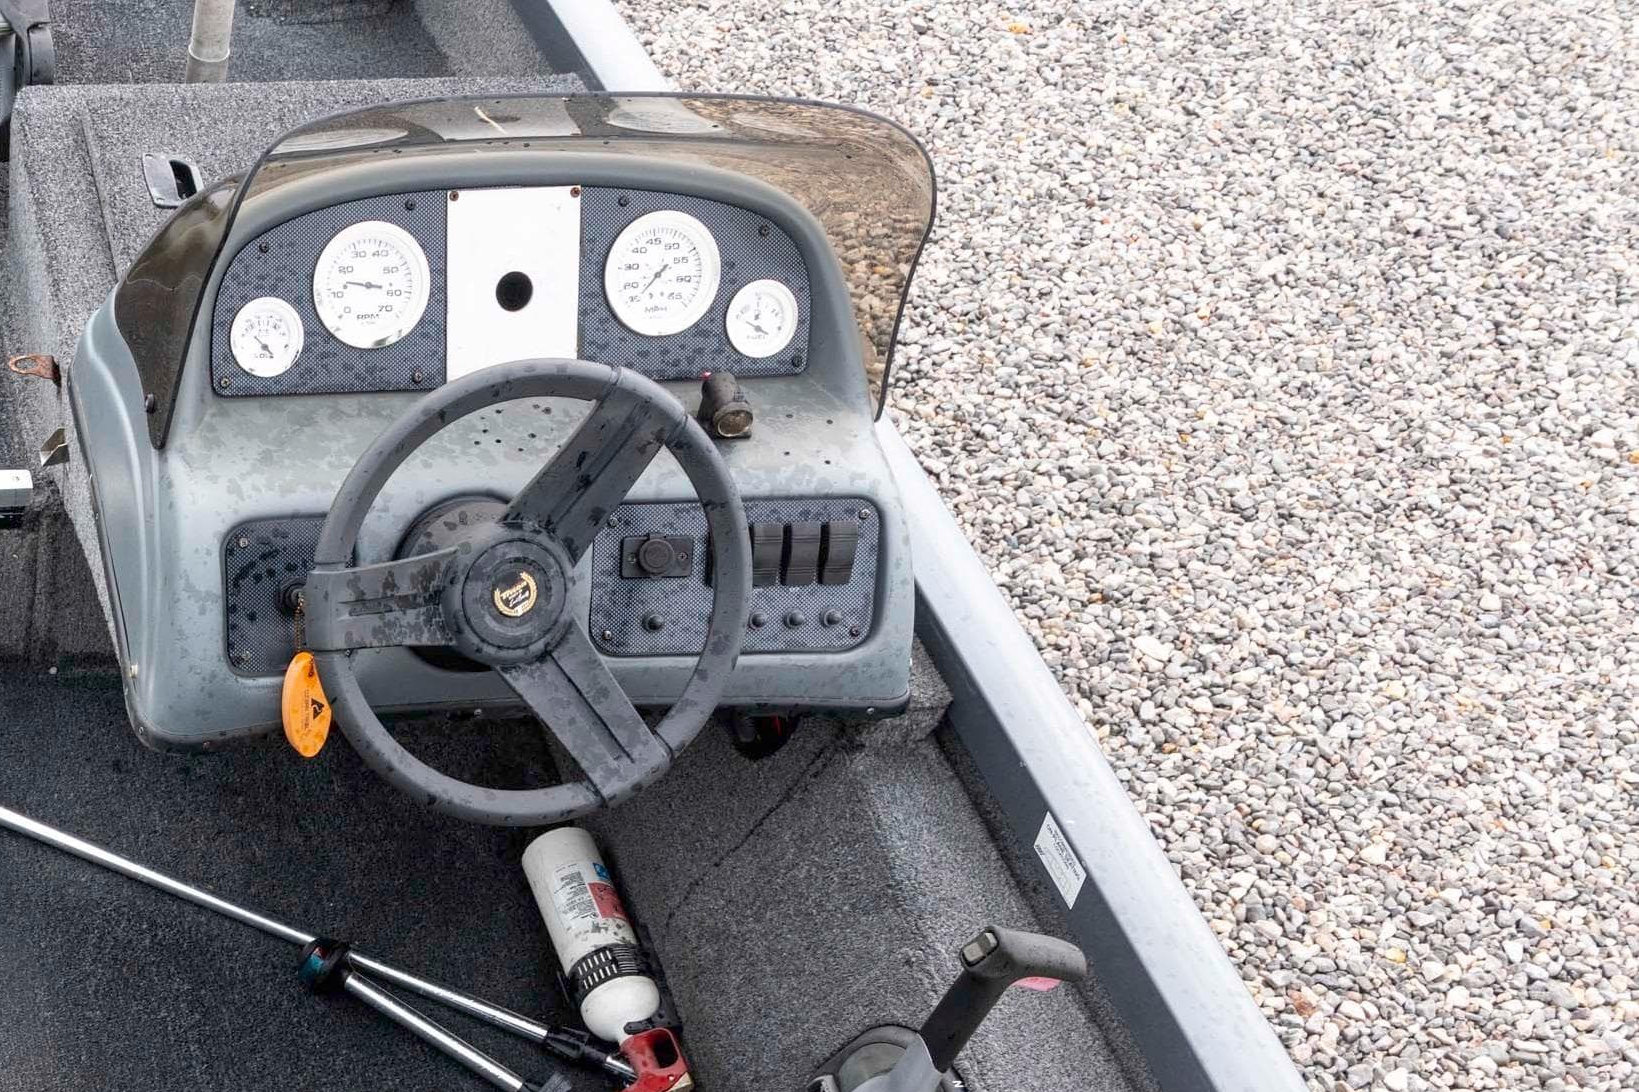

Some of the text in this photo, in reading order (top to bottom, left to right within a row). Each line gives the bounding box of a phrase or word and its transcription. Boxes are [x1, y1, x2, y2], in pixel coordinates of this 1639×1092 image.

[645, 237, 662, 246] 45
[631, 246, 648, 254] 40
[664, 242, 681, 251] 50
[351, 250, 368, 258] 30
[372, 249, 389, 257] 40
[673, 256, 689, 264] 55
[338, 265, 354, 274] 20
[383, 265, 400, 274] 50
[624, 263, 640, 271] 30
[675, 275, 692, 283] 60
[330, 290, 345, 299] 10
[386, 289, 403, 297] 60
[667, 292, 683, 300] 65
[343, 305, 352, 314] 0
[377, 304, 394, 313] 70
[356, 313, 380, 321] RPM
[952, 1079, 964, 1089] N
